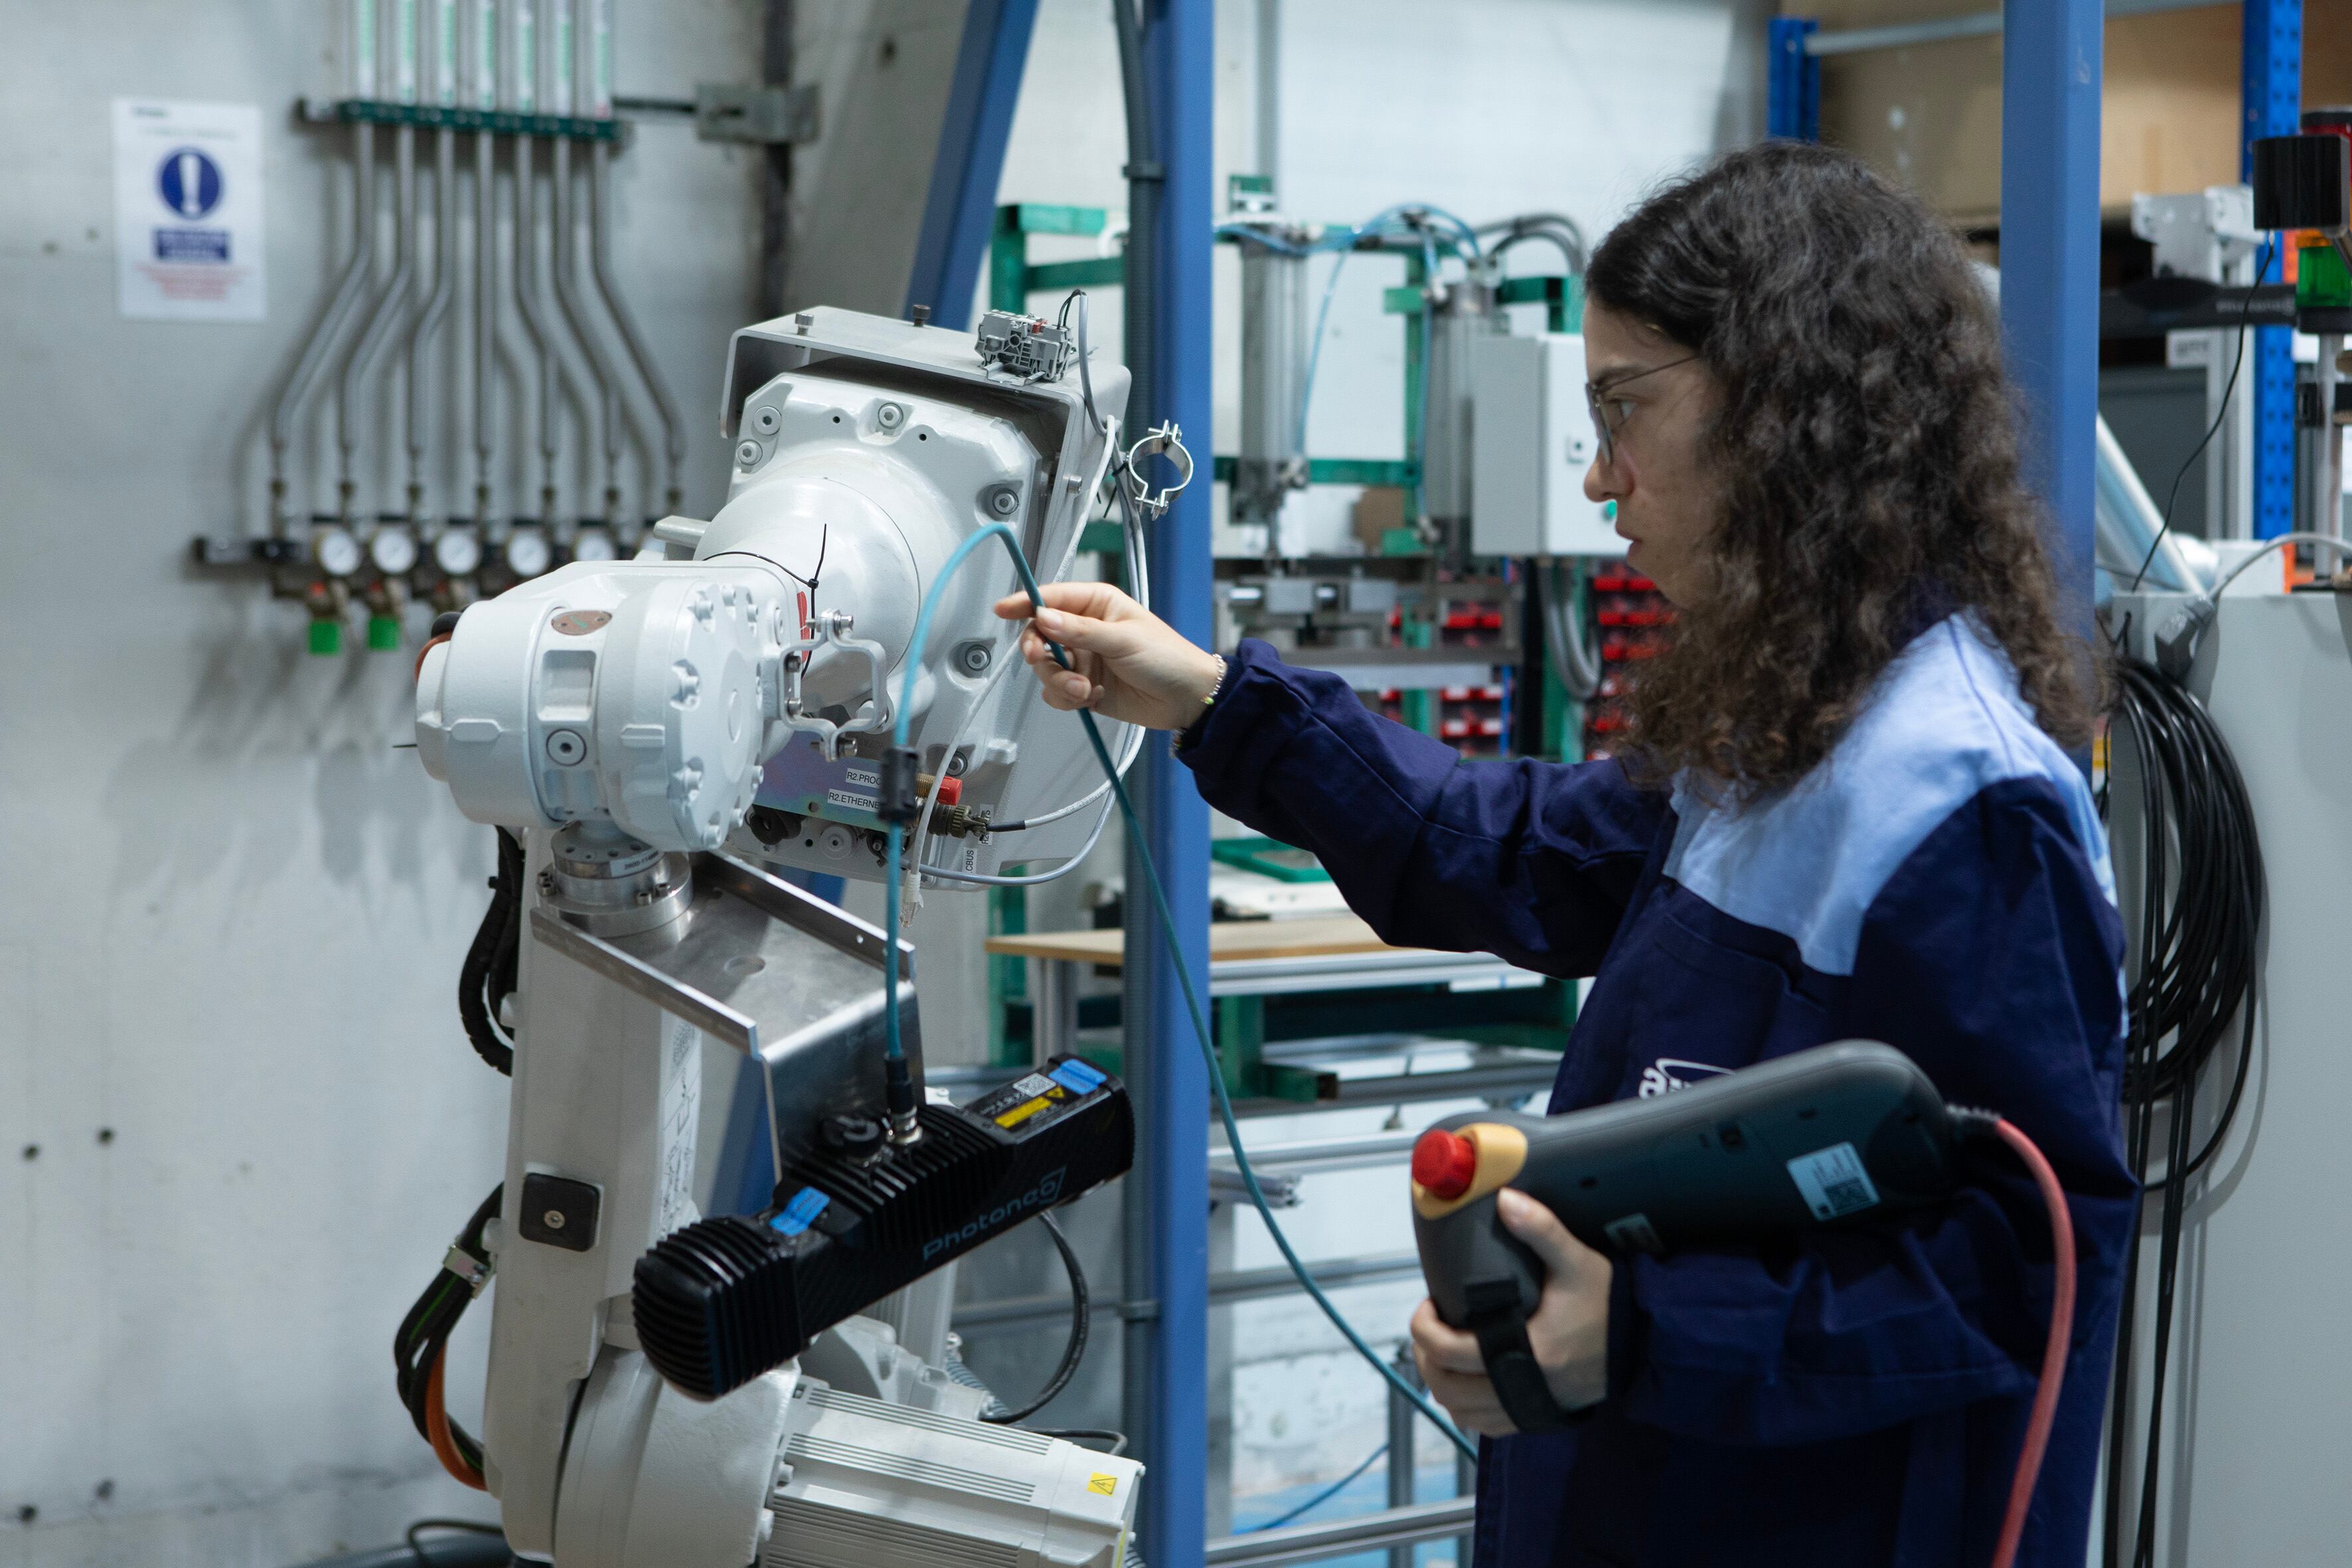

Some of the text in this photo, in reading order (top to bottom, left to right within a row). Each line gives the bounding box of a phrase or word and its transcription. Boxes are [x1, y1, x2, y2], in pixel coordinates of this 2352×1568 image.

[846, 771, 882, 785] R2.PROC
[828, 792, 880, 809] R2.ETHERNE
[965, 850, 975, 873] .CBUS
